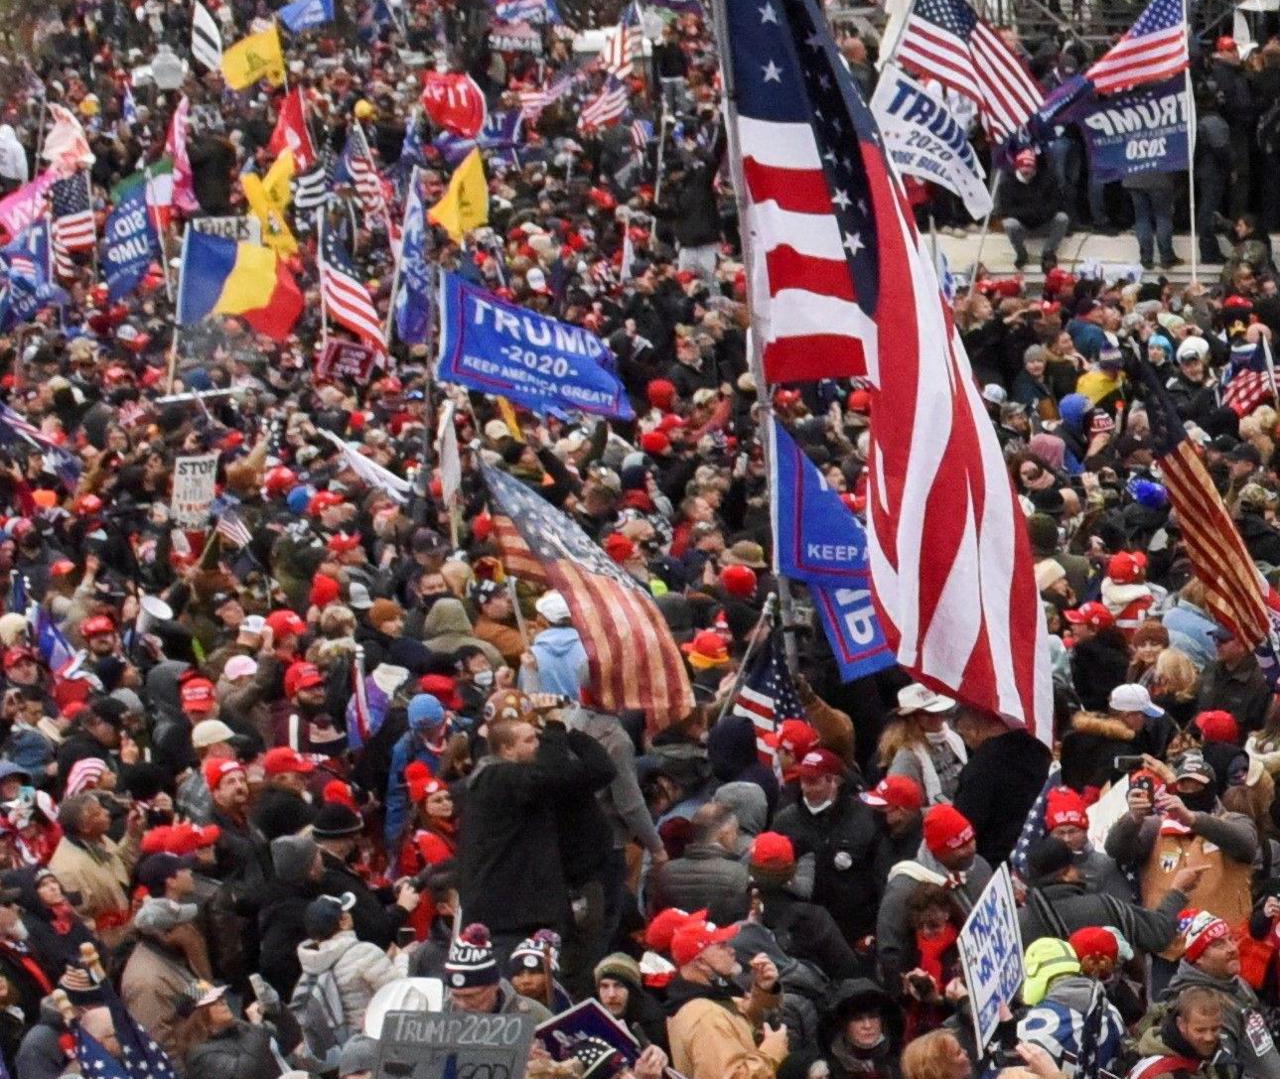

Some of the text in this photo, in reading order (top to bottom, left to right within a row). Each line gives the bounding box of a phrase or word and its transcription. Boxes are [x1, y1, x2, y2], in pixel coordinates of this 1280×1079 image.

[905, 130, 953, 161] 2020
[469, 296, 602, 358] TRUMP
[462, 354, 500, 375] KEEP
[500, 366, 558, 394] AMERICA
[807, 543, 858, 562] KEEP
